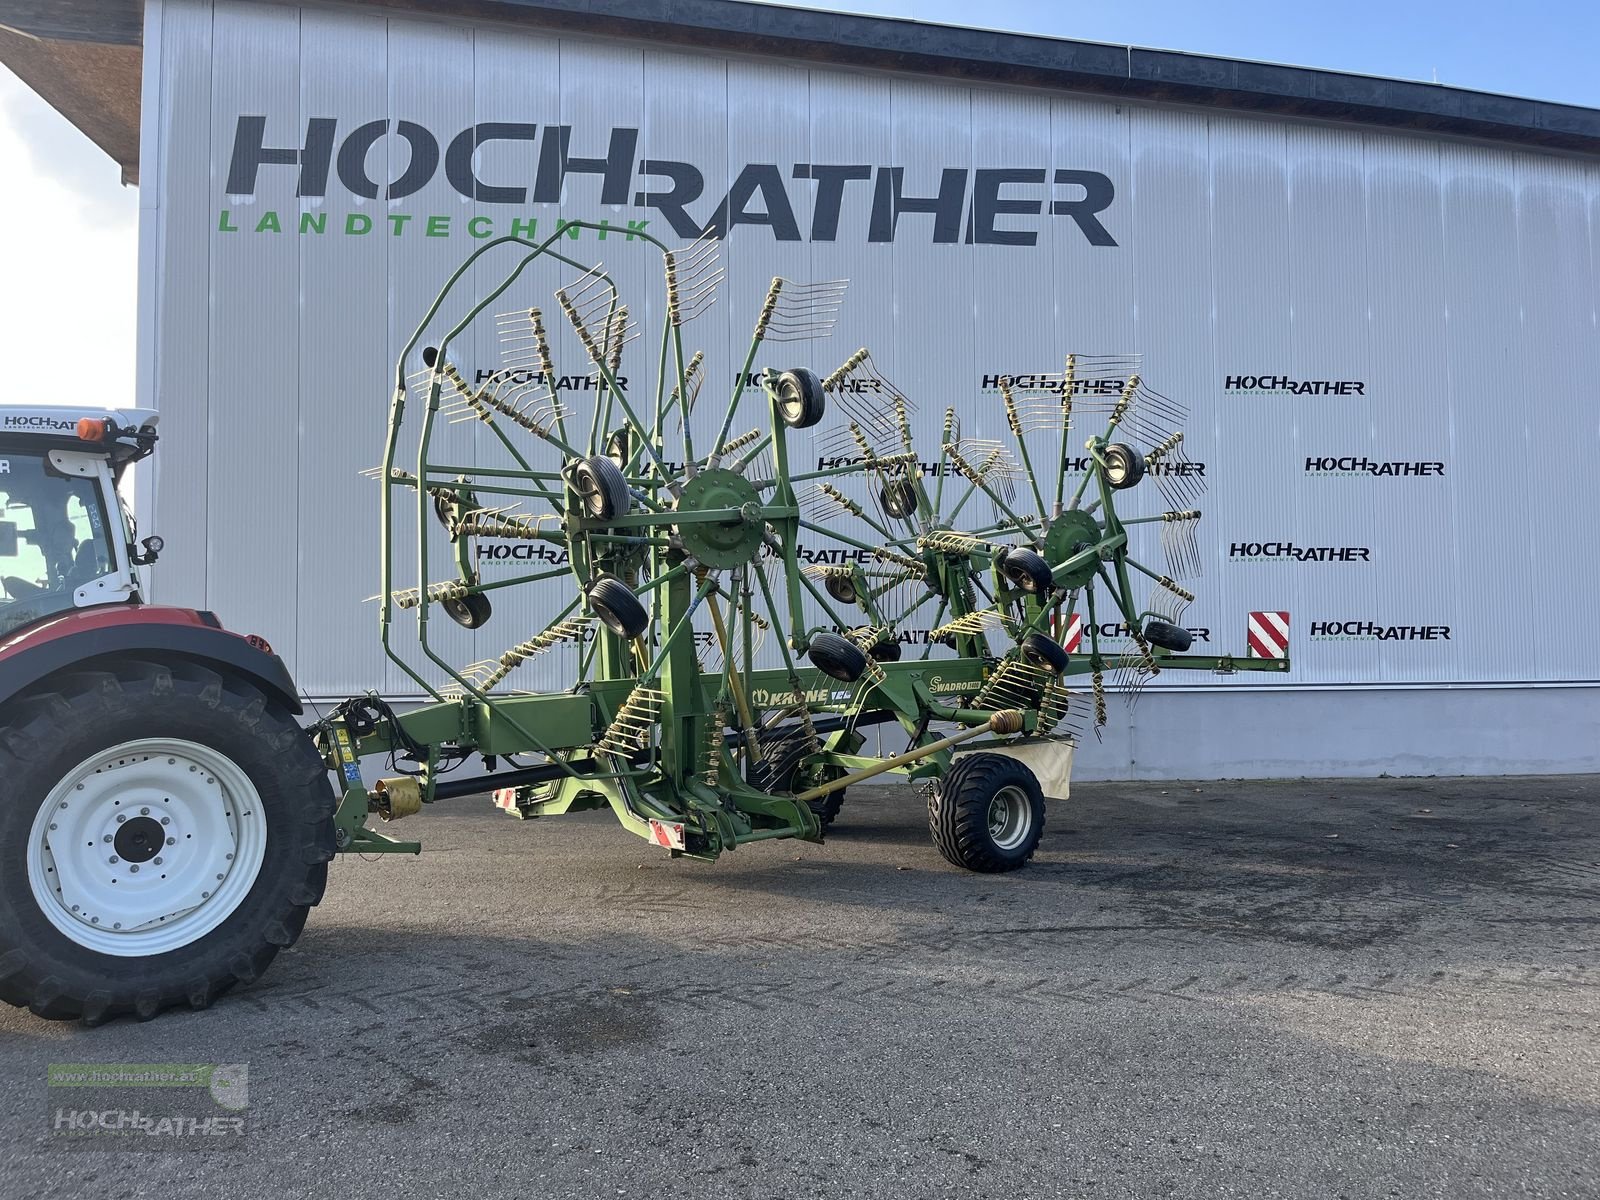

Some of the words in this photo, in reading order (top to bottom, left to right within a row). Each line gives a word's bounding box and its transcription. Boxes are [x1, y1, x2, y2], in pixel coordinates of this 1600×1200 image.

[225, 115, 1119, 247] HOCHRATHER
[218, 209, 651, 242] LANDTECHNIK
[1225, 375, 1365, 396] HOCHRATHER
[1305, 457, 1445, 477] HOCHRATHER
[1229, 542, 1370, 562] HOCHRATHER
[1310, 621, 1451, 641] HOCHRATHER
